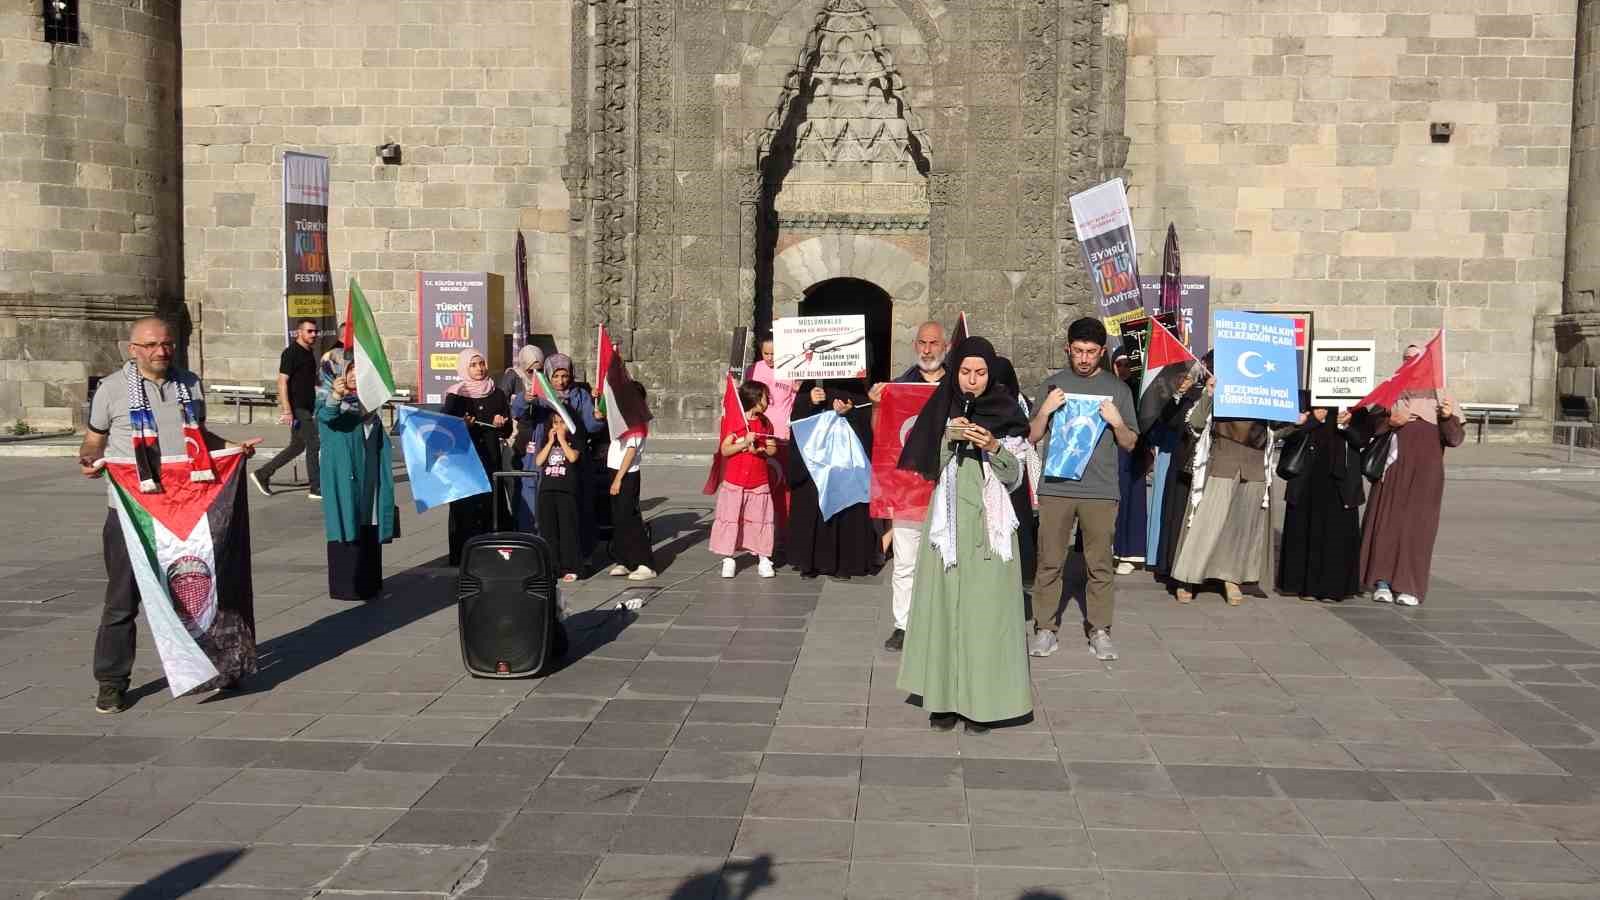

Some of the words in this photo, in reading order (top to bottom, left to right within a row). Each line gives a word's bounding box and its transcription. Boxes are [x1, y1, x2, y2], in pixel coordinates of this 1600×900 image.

[294, 272, 327, 282] FESTİV
[435, 302, 473, 311] TÜRKİYE
[435, 312, 474, 328] KÜLTÜR
[440, 323, 470, 340] YOLU
[1248, 322, 1261, 332] EY
[435, 340, 474, 348] FESTİVALİ
